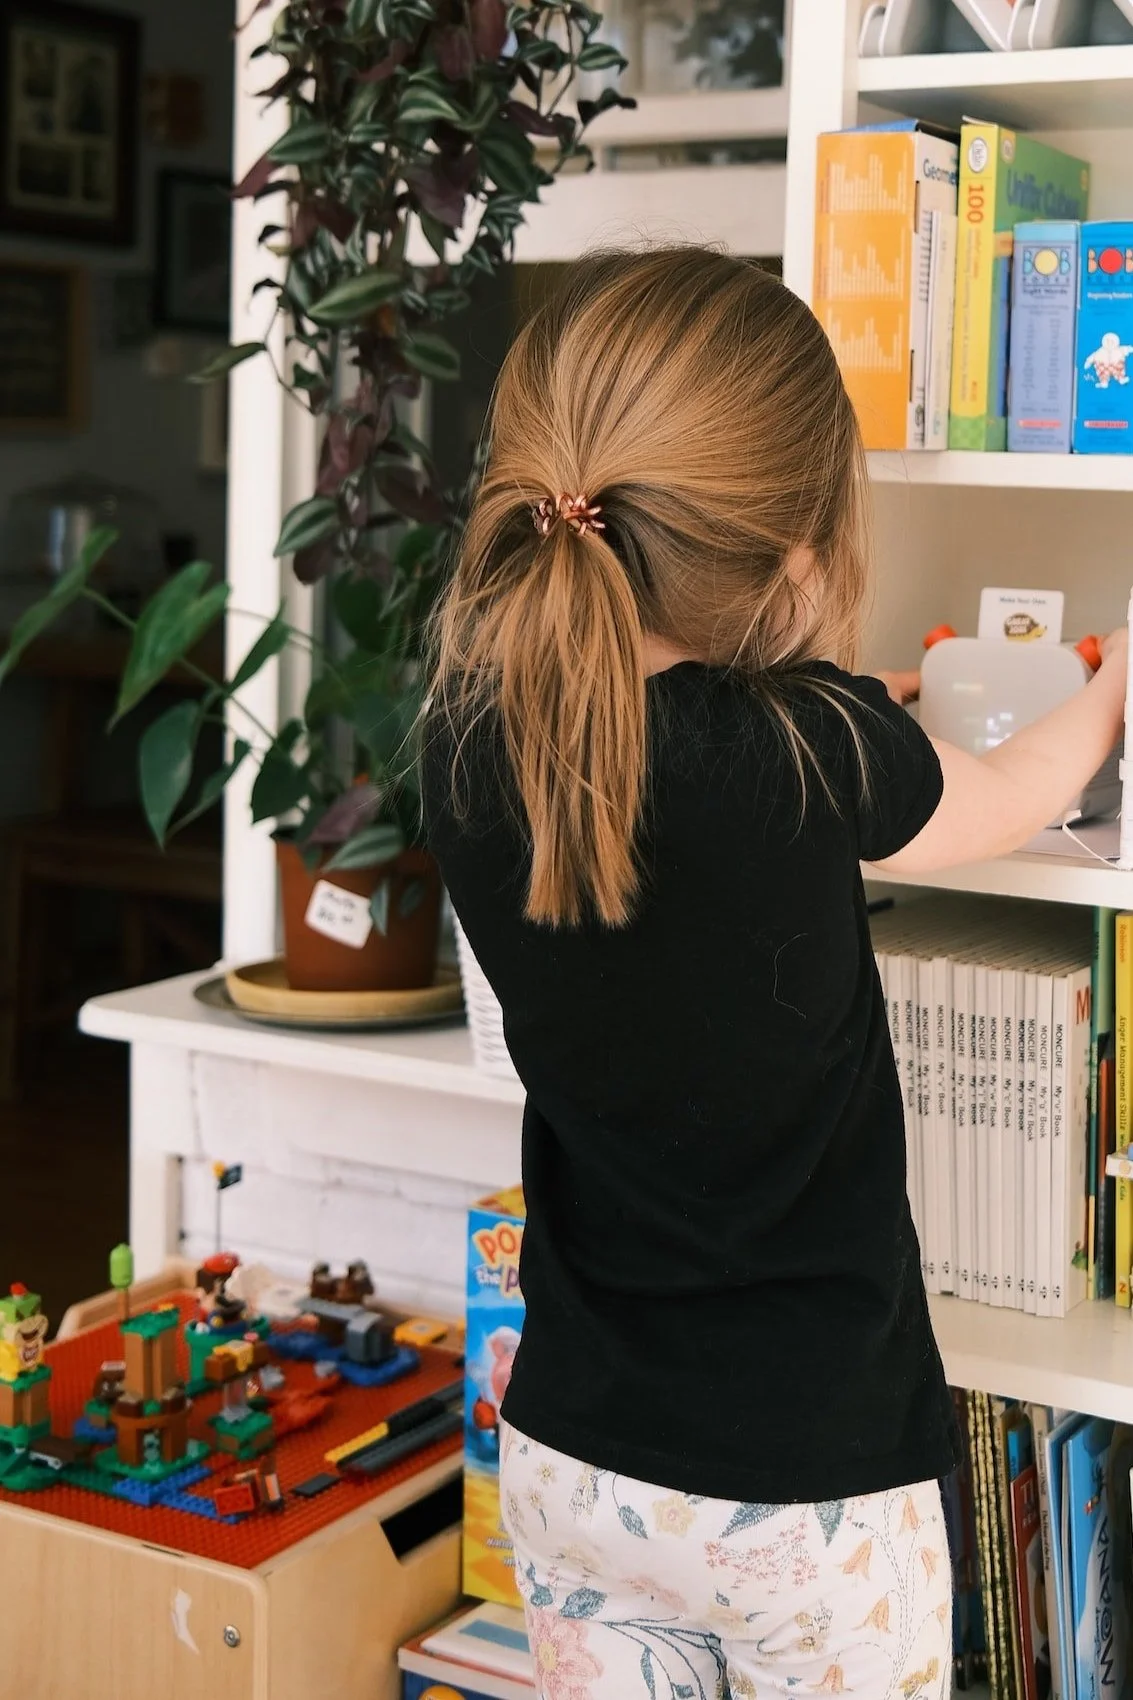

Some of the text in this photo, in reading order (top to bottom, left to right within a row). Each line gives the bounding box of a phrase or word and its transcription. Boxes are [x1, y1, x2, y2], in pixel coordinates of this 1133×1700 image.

[967, 184, 984, 224] 100
[1022, 247, 1071, 276] BOB
[892, 1001, 900, 1045] MONCURE
[905, 1000, 913, 1043] MONCURE
[1075, 984, 1090, 1026] M
[922, 1007, 930, 1051] MONCURE
[936, 1004, 945, 1049] MONCURE
[957, 1013, 965, 1058] MONCURE
[978, 1015, 986, 1061] MONCURE
[1004, 1016, 1012, 1062] MONCURE
[1055, 1023, 1063, 1069] MONCURE
[1118, 1015, 1127, 1042] Anger
[1039, 1025, 1048, 1071] MONCURE
[922, 1064, 930, 1076] My
[936, 1062, 945, 1075] My
[957, 1074, 965, 1087] My
[978, 1075, 986, 1088] My
[989, 1074, 997, 1086] My
[1003, 1078, 1011, 1090] My
[1026, 1018, 1035, 1142] MONCURE My First Book
[1117, 1045, 1127, 1101] Management
[1039, 1085, 1047, 1099] My
[1053, 1085, 1062, 1099] My
[1039, 1116, 1047, 1138] Book
[1054, 1114, 1062, 1137] Book
[1118, 1103, 1127, 1130] Skills
[1097, 1515, 1116, 1687] MOANA
